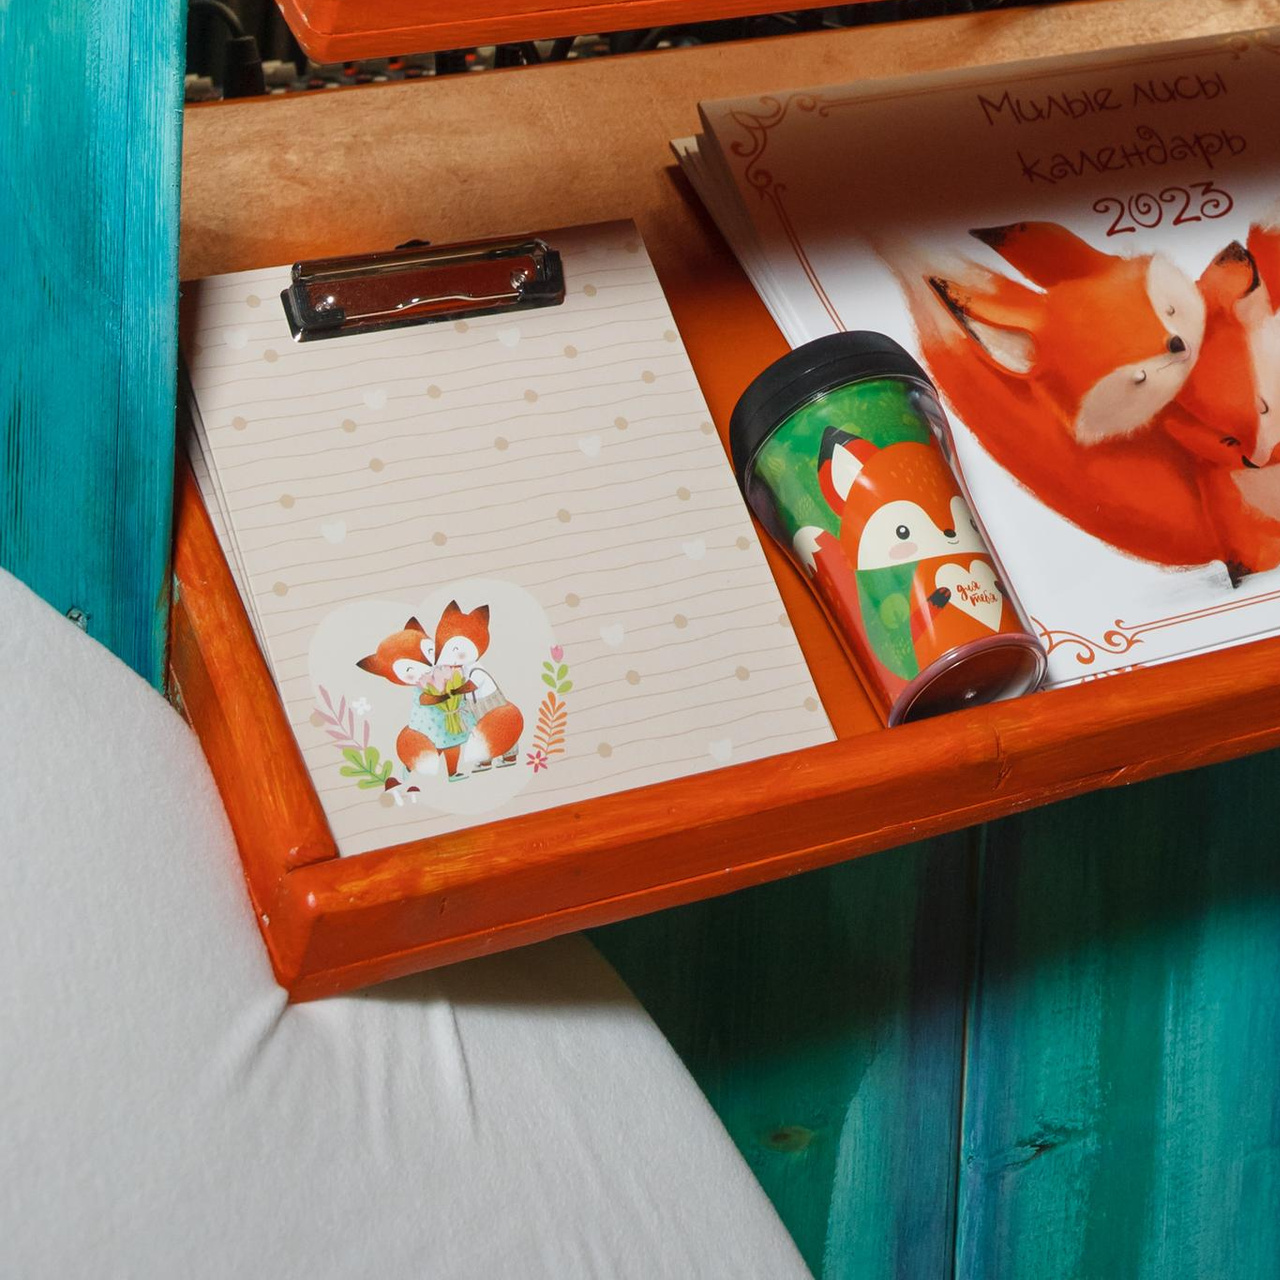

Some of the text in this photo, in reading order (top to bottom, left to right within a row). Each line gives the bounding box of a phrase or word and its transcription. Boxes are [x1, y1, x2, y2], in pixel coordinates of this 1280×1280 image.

[977, 72, 1228, 126] Милые лисы
[1017, 125, 1247, 185] календарь
[1093, 181, 1234, 237] 2023
[958, 582, 980, 602] для
[970, 591, 998, 607] тебя
